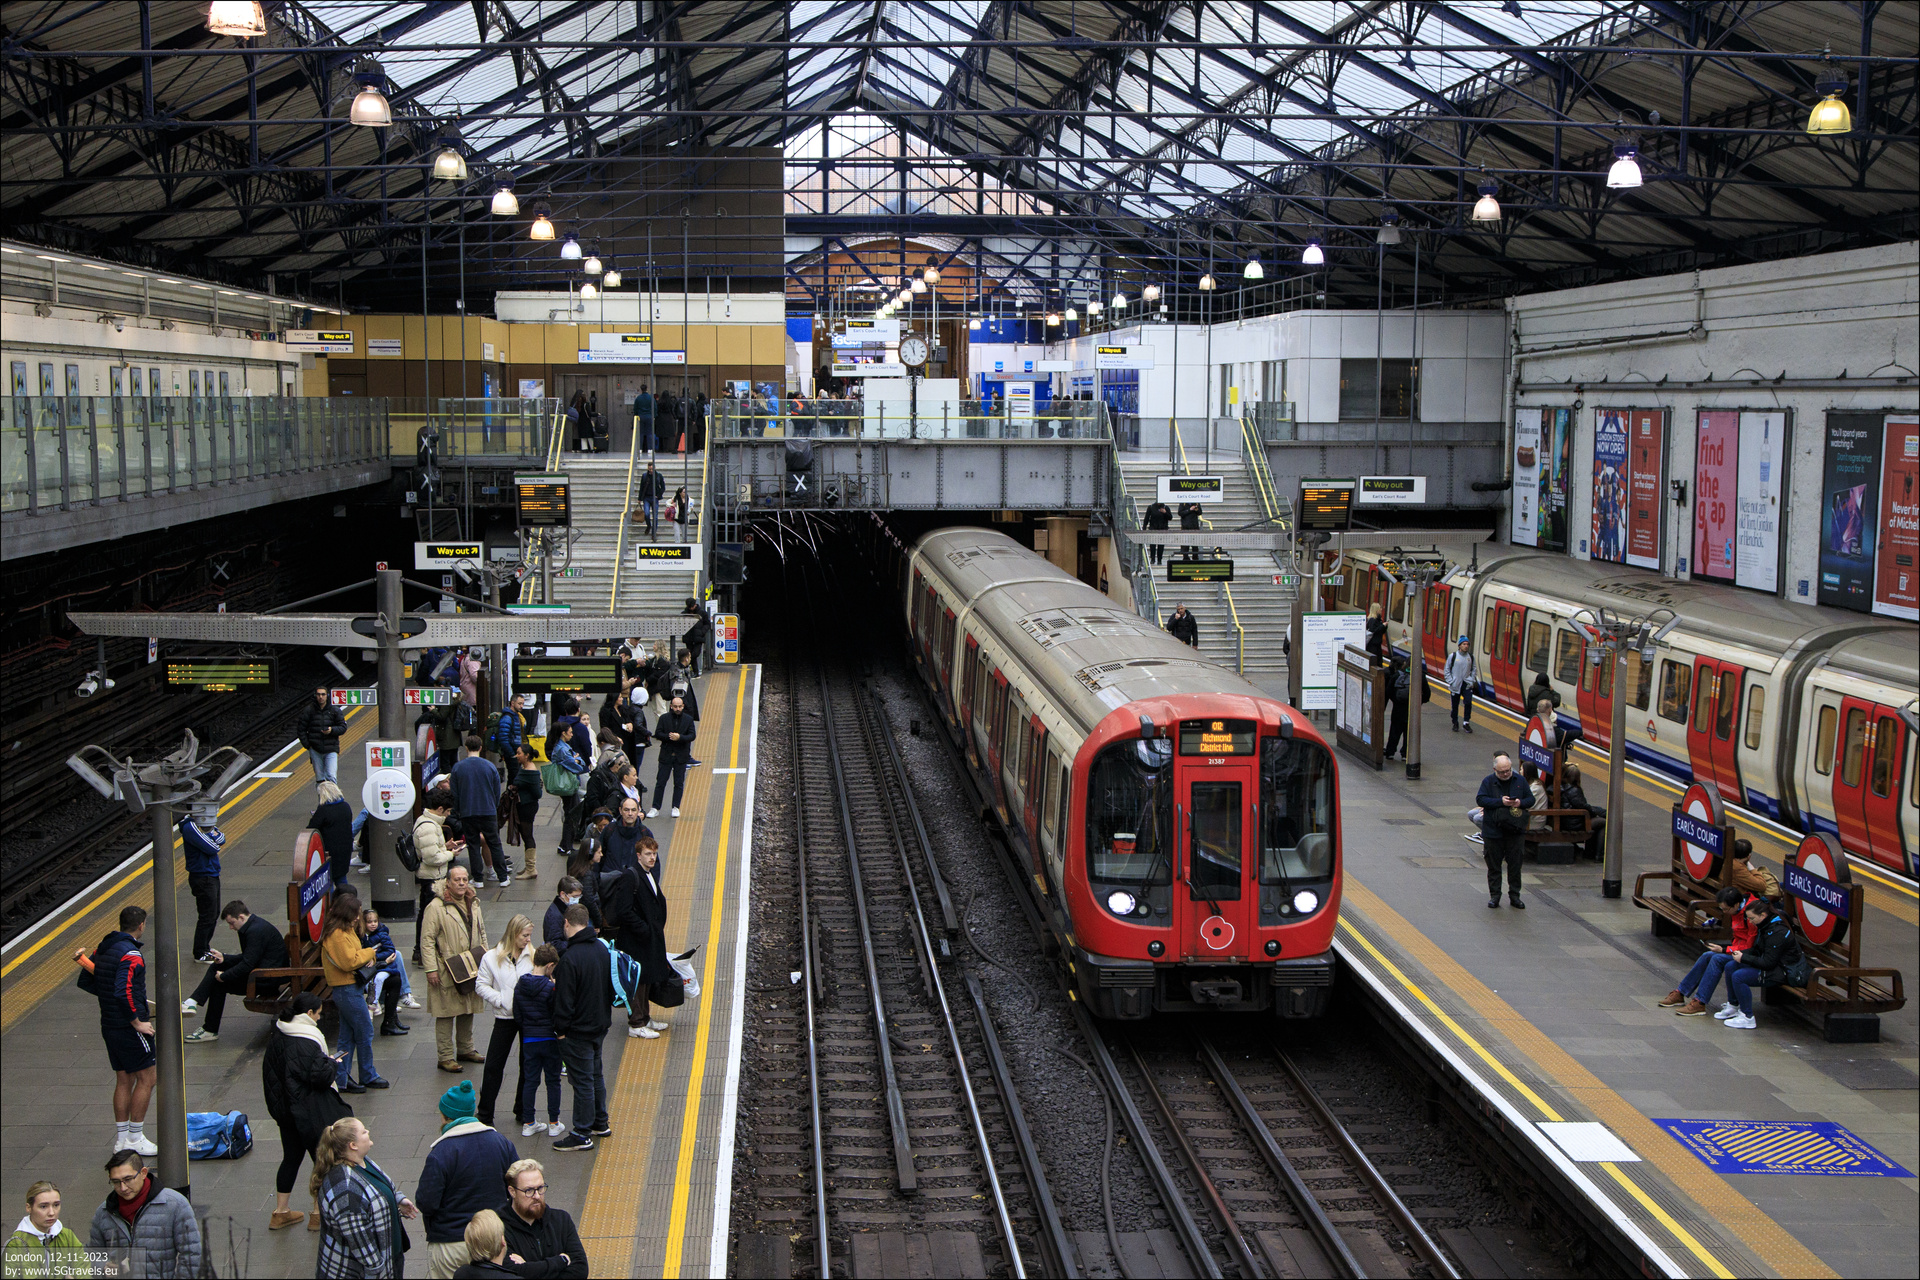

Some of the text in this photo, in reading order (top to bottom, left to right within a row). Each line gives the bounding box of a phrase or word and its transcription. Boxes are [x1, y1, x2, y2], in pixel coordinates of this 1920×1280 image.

[1613, 434, 1625, 442] STORE
[1596, 442, 1625, 454] NOW OPEN
[1700, 434, 1724, 466] find
[1831, 440, 1850, 450] watching
[1180, 481, 1197, 489] Way
[1373, 481, 1389, 489] Way
[1700, 469, 1719, 499] the
[1892, 501, 1911, 515] Never
[1889, 516, 1897, 528] of
[437, 547, 454, 556] Way
[649, 549, 666, 557] Way
[1202, 733, 1232, 742] Richmond
[1200, 743, 1233, 752] District line
[1522, 744, 1549, 766] EARL'S COURT
[1677, 818, 1718, 847] EARL'S COURT
[303, 870, 328, 906] EARL'S COURT
[1790, 872, 1842, 908] EARL'S COURT
